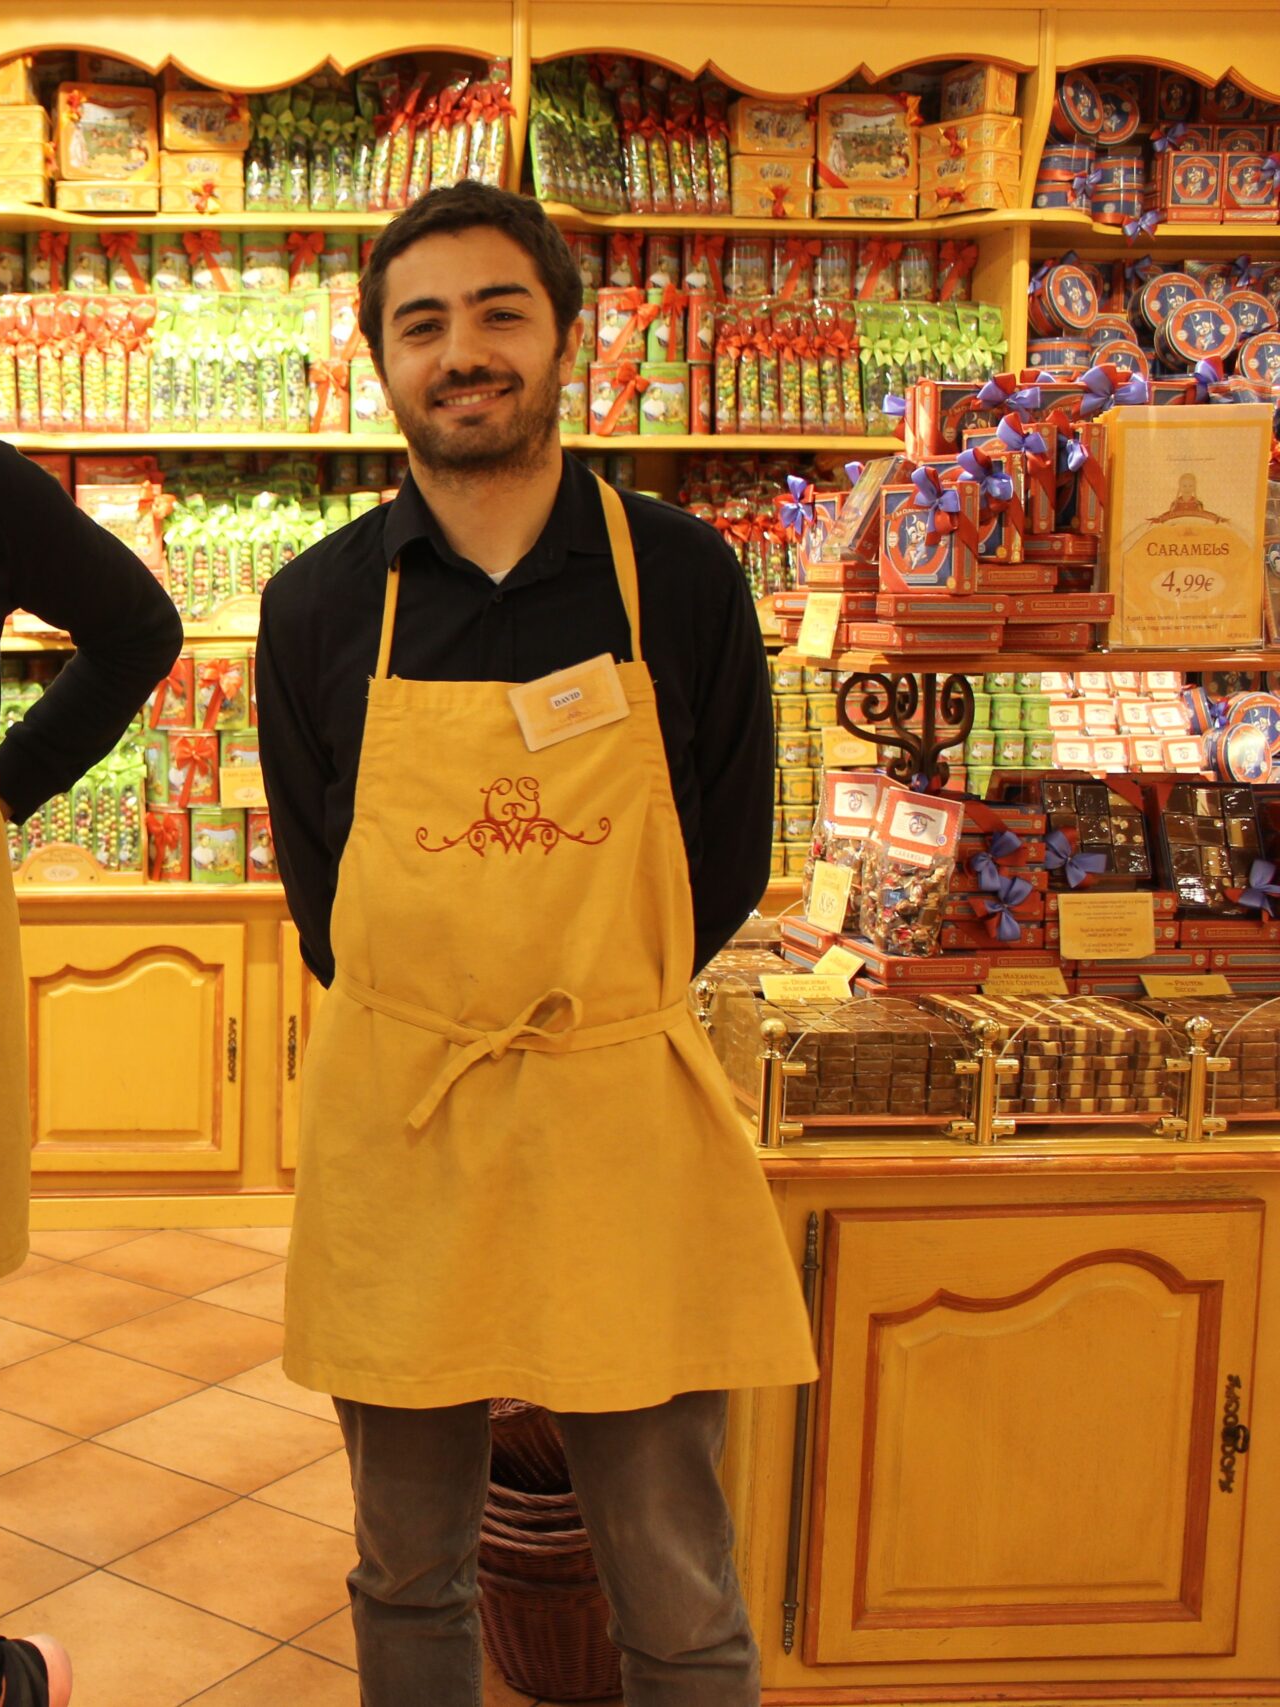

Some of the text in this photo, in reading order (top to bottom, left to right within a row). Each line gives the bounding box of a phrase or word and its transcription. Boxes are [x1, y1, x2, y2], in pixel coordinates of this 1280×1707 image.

[1146, 542, 1230, 556] CARAMELS
[1161, 570, 1214, 597] 4,99€
[554, 691, 581, 707] DAVID
